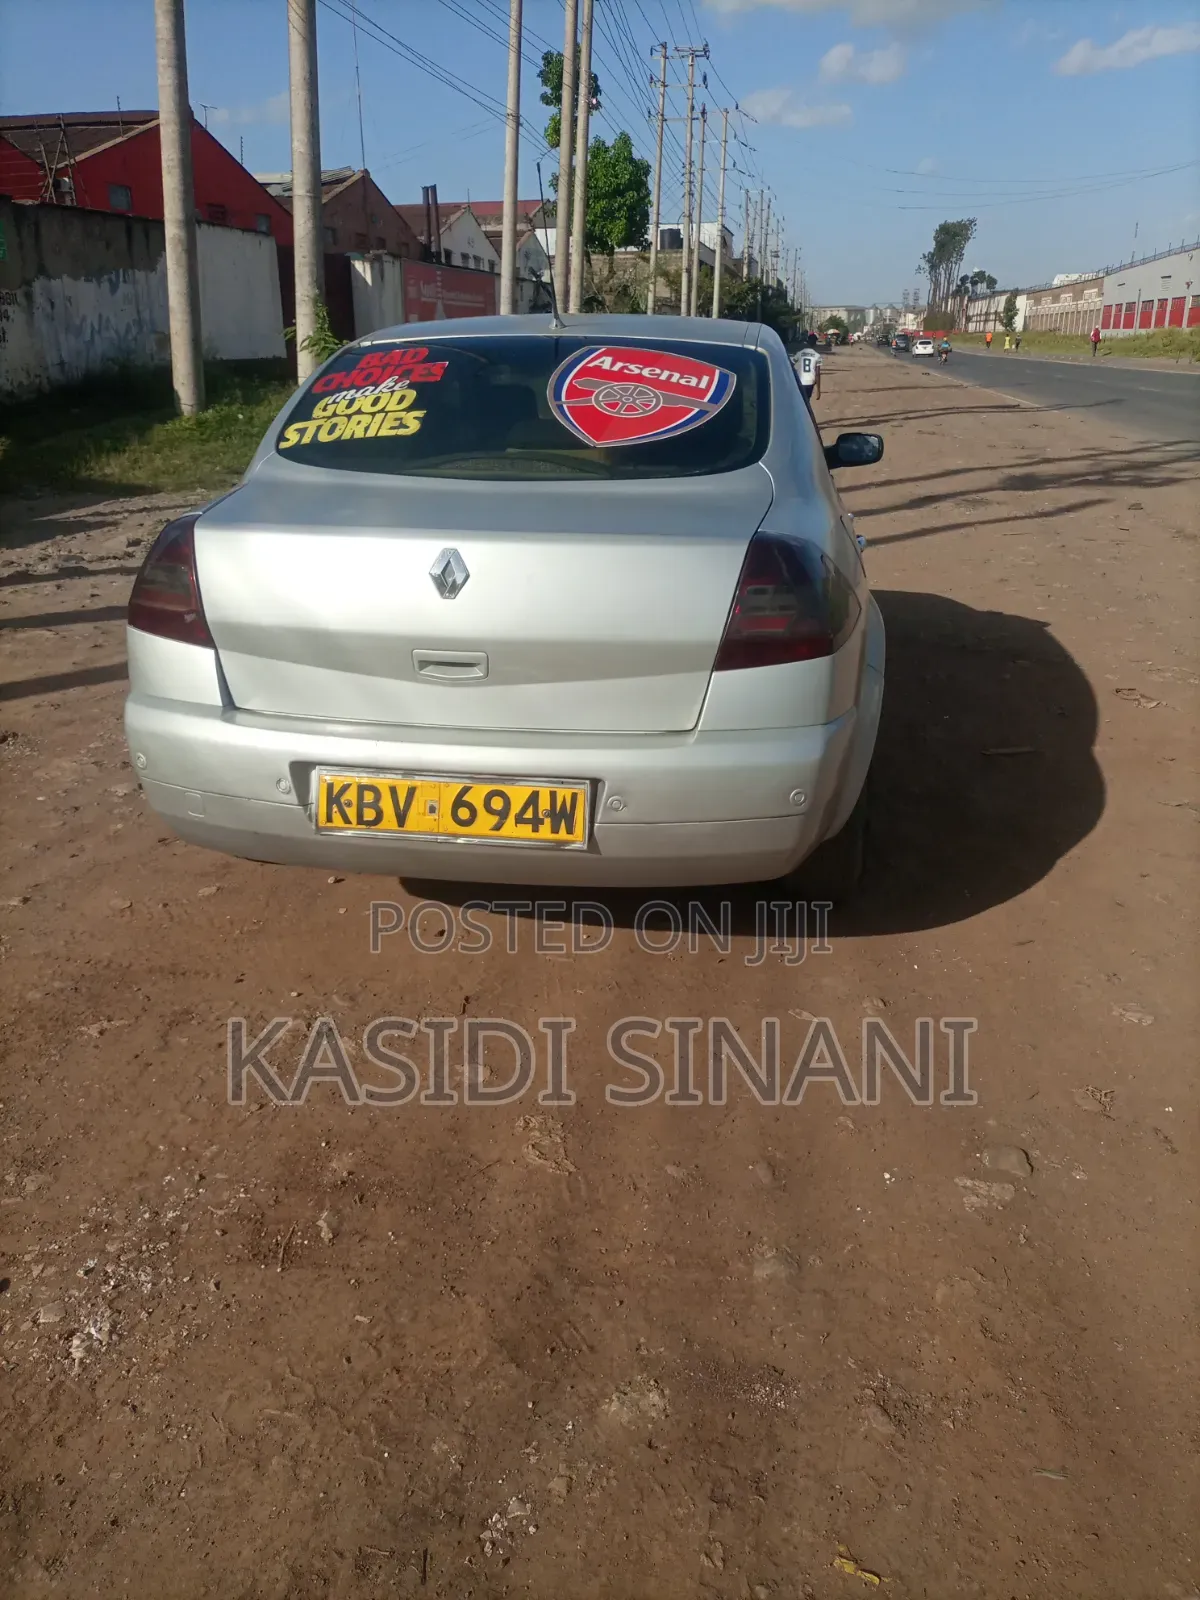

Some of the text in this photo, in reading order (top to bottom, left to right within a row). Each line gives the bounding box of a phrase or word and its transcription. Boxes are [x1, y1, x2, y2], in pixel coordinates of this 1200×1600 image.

[355, 347, 429, 369] BAD
[586, 356, 709, 389] Arsenal
[803, 358, 811, 372] 8
[312, 361, 449, 393] CHOICES
[328, 375, 410, 404] make
[312, 389, 417, 420] GOOD
[278, 410, 427, 449] STORIES
[325, 781, 579, 835] KBV 694W
